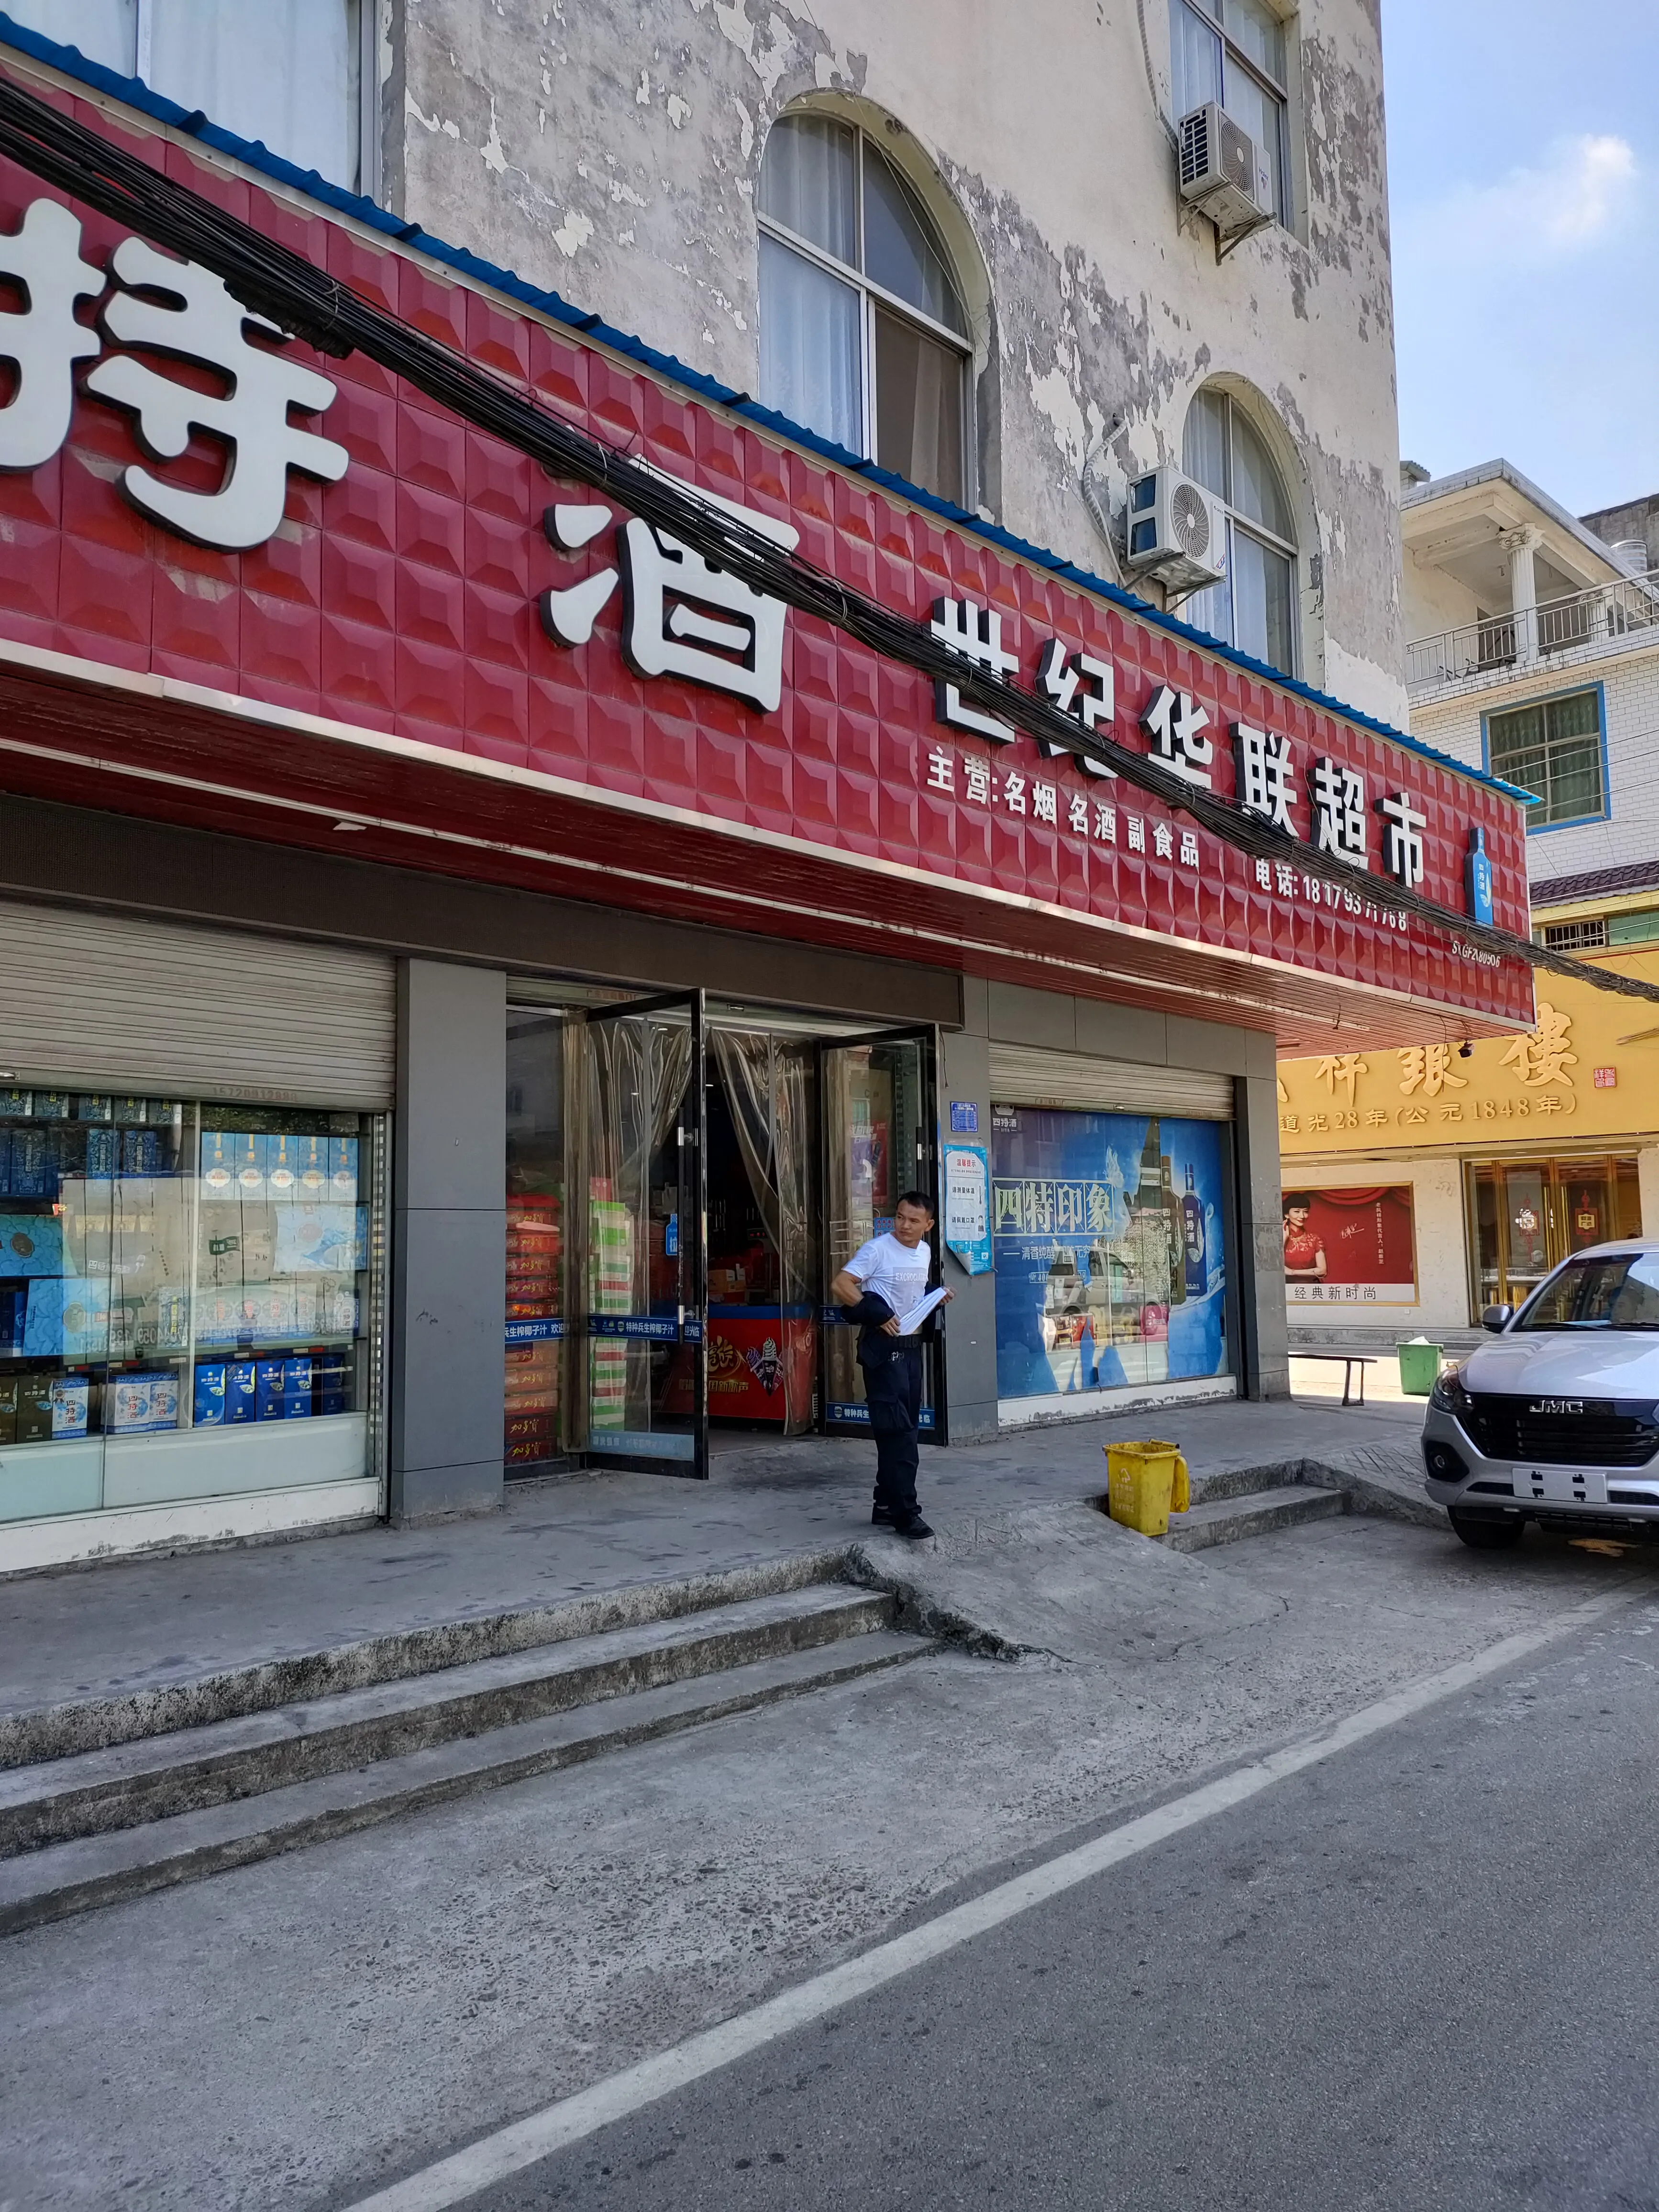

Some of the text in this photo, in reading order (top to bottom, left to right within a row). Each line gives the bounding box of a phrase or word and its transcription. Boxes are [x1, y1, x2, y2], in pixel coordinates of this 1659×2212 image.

[931, 596, 1427, 888] 世纪华联超市
[993, 1117, 1017, 1128] 四特酒
[952, 1186, 975, 1194] 请测量体温
[995, 1182, 1113, 1233] 四特印象
[1186, 1210, 1195, 1242] 四特酒
[1294, 1286, 1376, 1300] 经典新时尚
[626, 1322, 674, 1336] 特种兵生榨椰子汁
[65, 1400, 77, 1424] 四特酒
[127, 1395, 138, 1419] 四特酒
[156, 1393, 167, 1416] 四特酒
[1529, 1400, 1583, 1414] JMC
